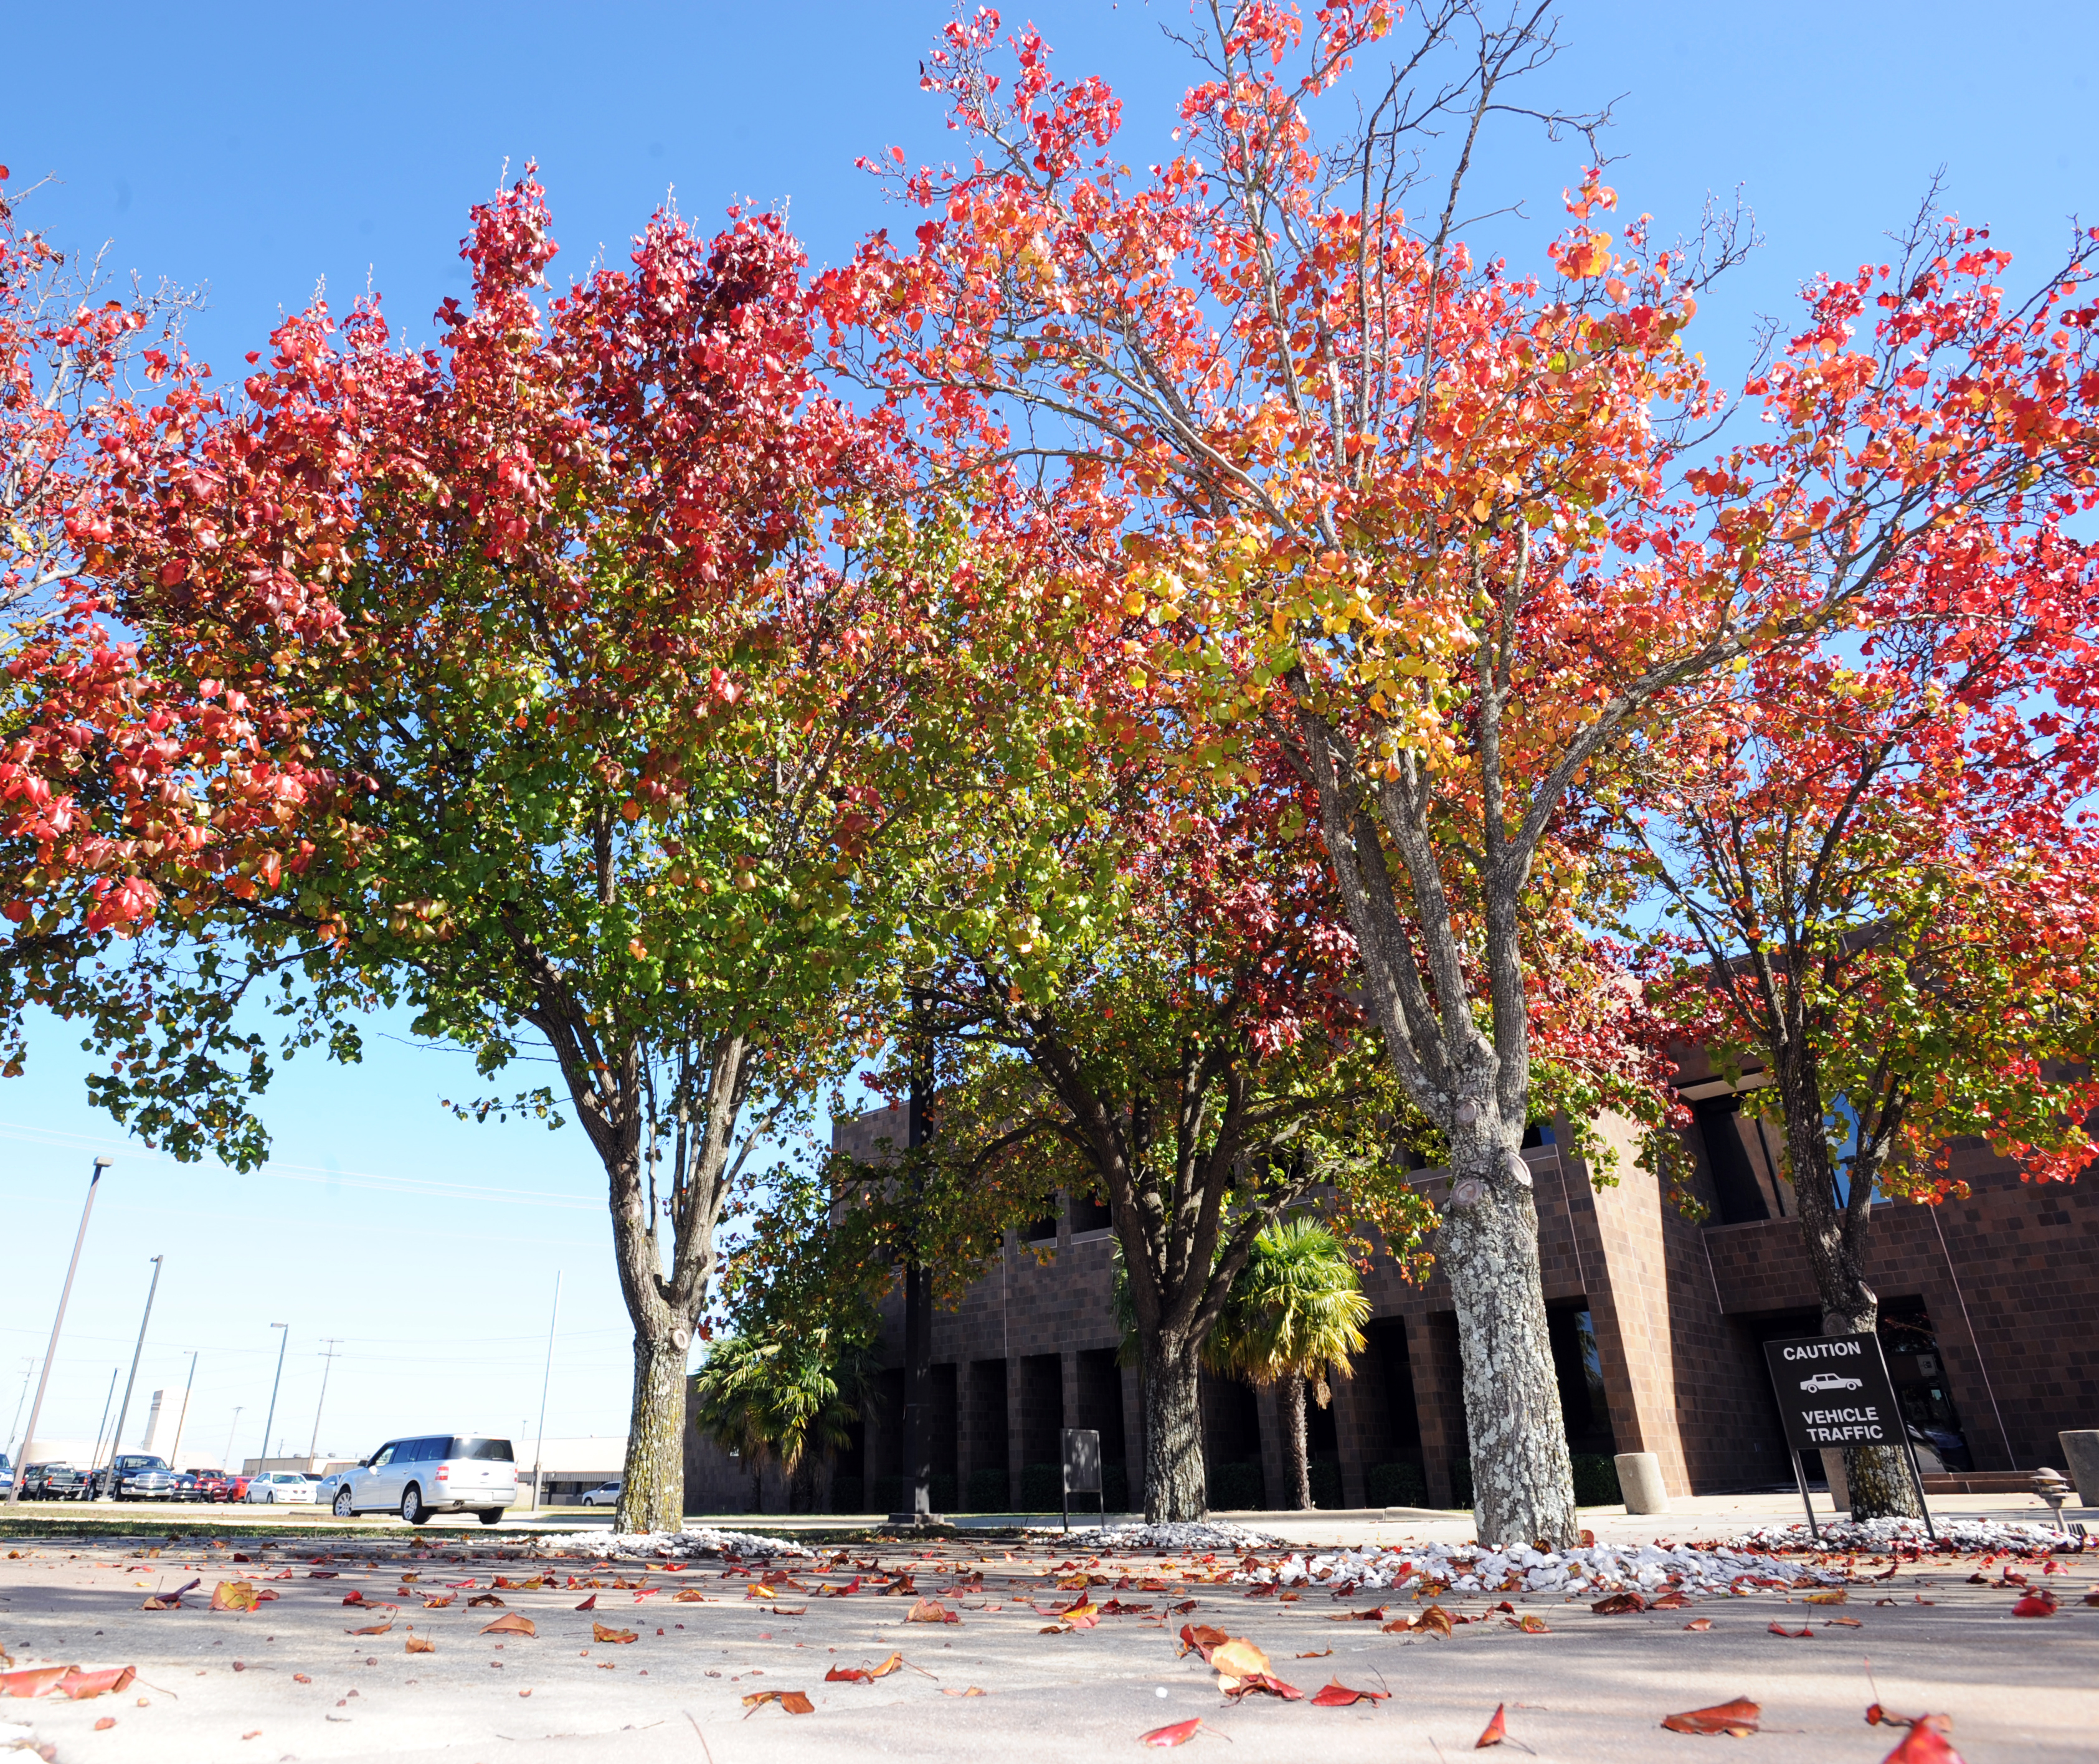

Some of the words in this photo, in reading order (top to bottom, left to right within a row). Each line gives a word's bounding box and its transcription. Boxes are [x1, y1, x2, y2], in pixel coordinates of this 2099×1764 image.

[1783, 1341, 1861, 1360] CAUTION
[1801, 1406, 1879, 1425] VEHICLE
[1806, 1425, 1883, 1442] TRAFFIC
